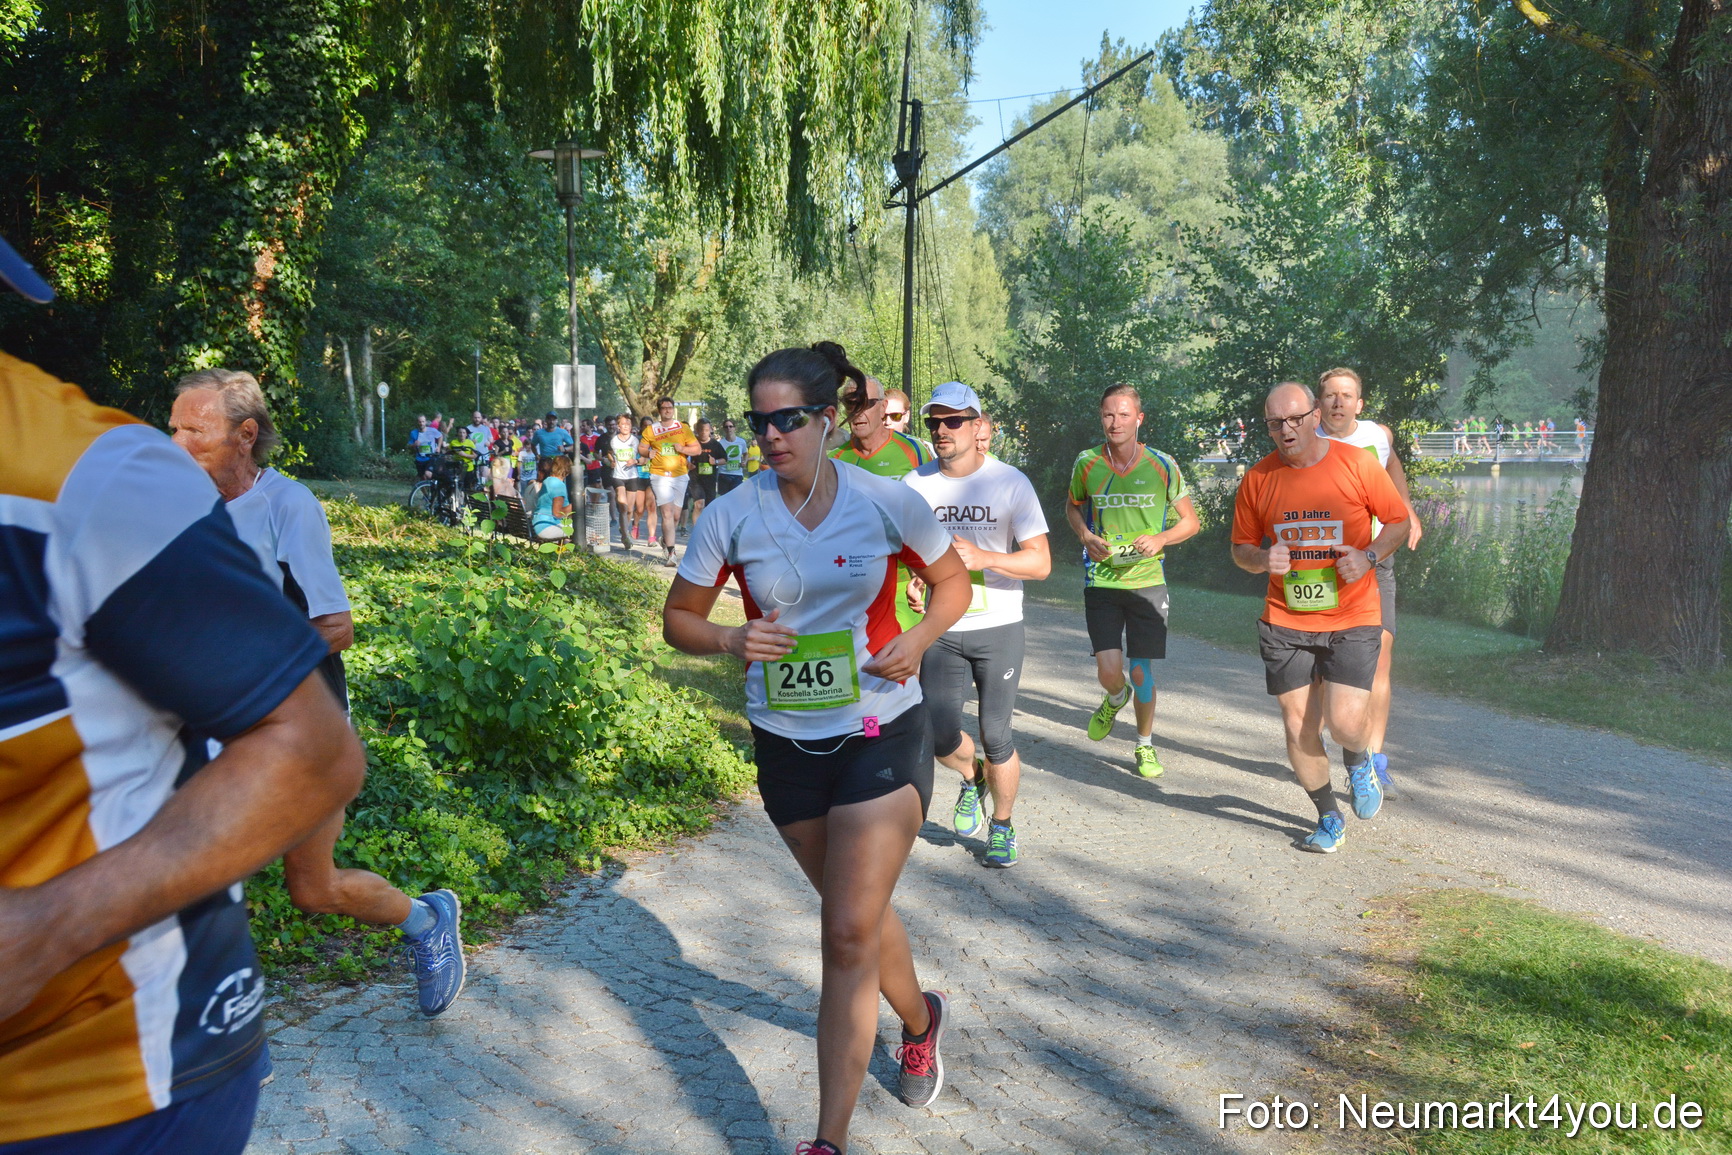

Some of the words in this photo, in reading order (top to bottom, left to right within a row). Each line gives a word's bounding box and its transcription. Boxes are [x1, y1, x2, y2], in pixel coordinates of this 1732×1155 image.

[1091, 493, 1156, 508] BOCK
[933, 505, 998, 523] GRADL
[1283, 511, 1299, 521] 30
[1302, 509, 1331, 519] Jahre
[1280, 526, 1338, 541] OBI
[1289, 547, 1342, 560] eumark
[1293, 584, 1324, 599] 902
[778, 660, 835, 689] 246
[777, 689, 811, 698] Koschella
[812, 687, 843, 696] Sabrina
